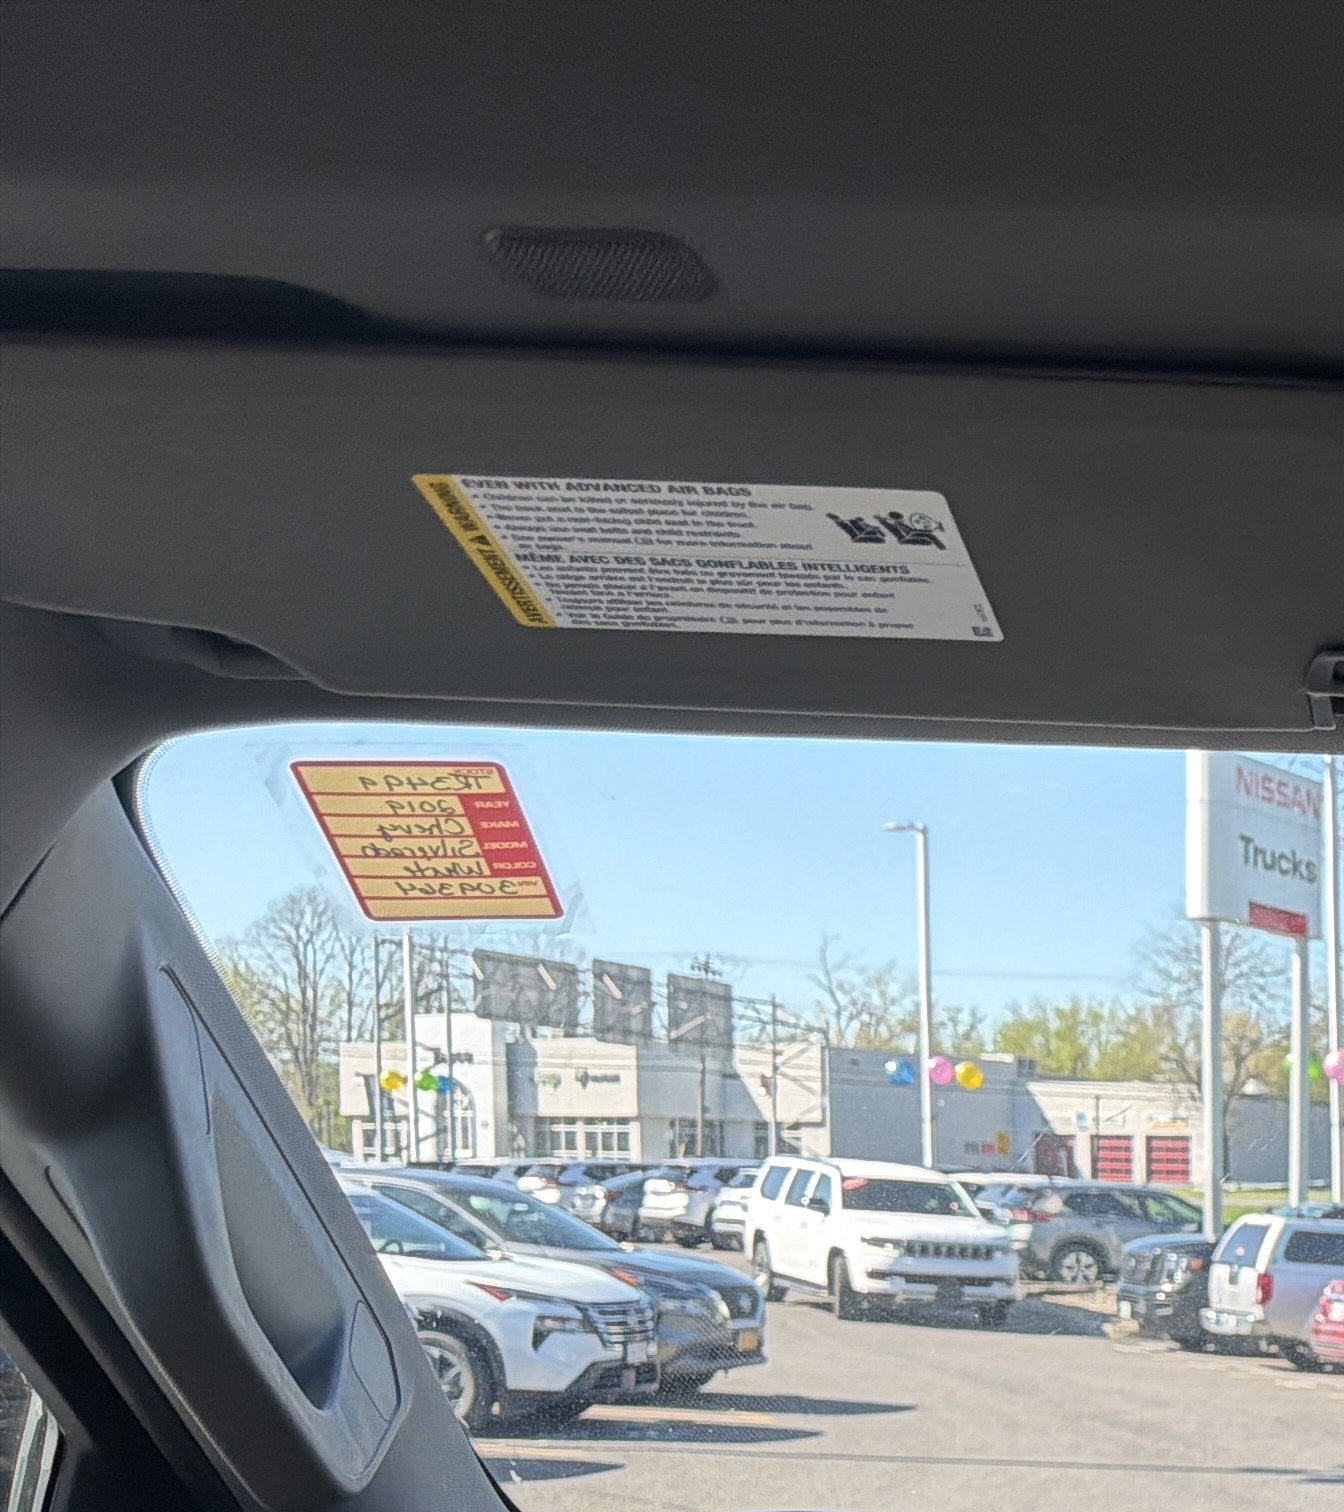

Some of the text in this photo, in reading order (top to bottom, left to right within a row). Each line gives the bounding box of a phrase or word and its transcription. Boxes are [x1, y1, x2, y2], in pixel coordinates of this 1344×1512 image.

[429, 482, 479, 532] WARNING
[460, 479, 752, 497] EVEN WITH ADVANCED AIR BAGS
[514, 552, 566, 563] MÊME
[569, 554, 610, 565] AVEC
[614, 556, 647, 566] DES
[648, 557, 692, 568] SACS
[697, 558, 798, 572] GONFLABLES
[802, 562, 912, 575] INTELLIGENTS
[1235, 766, 1320, 819] NISSAN
[1239, 834, 1318, 884] Trucks
